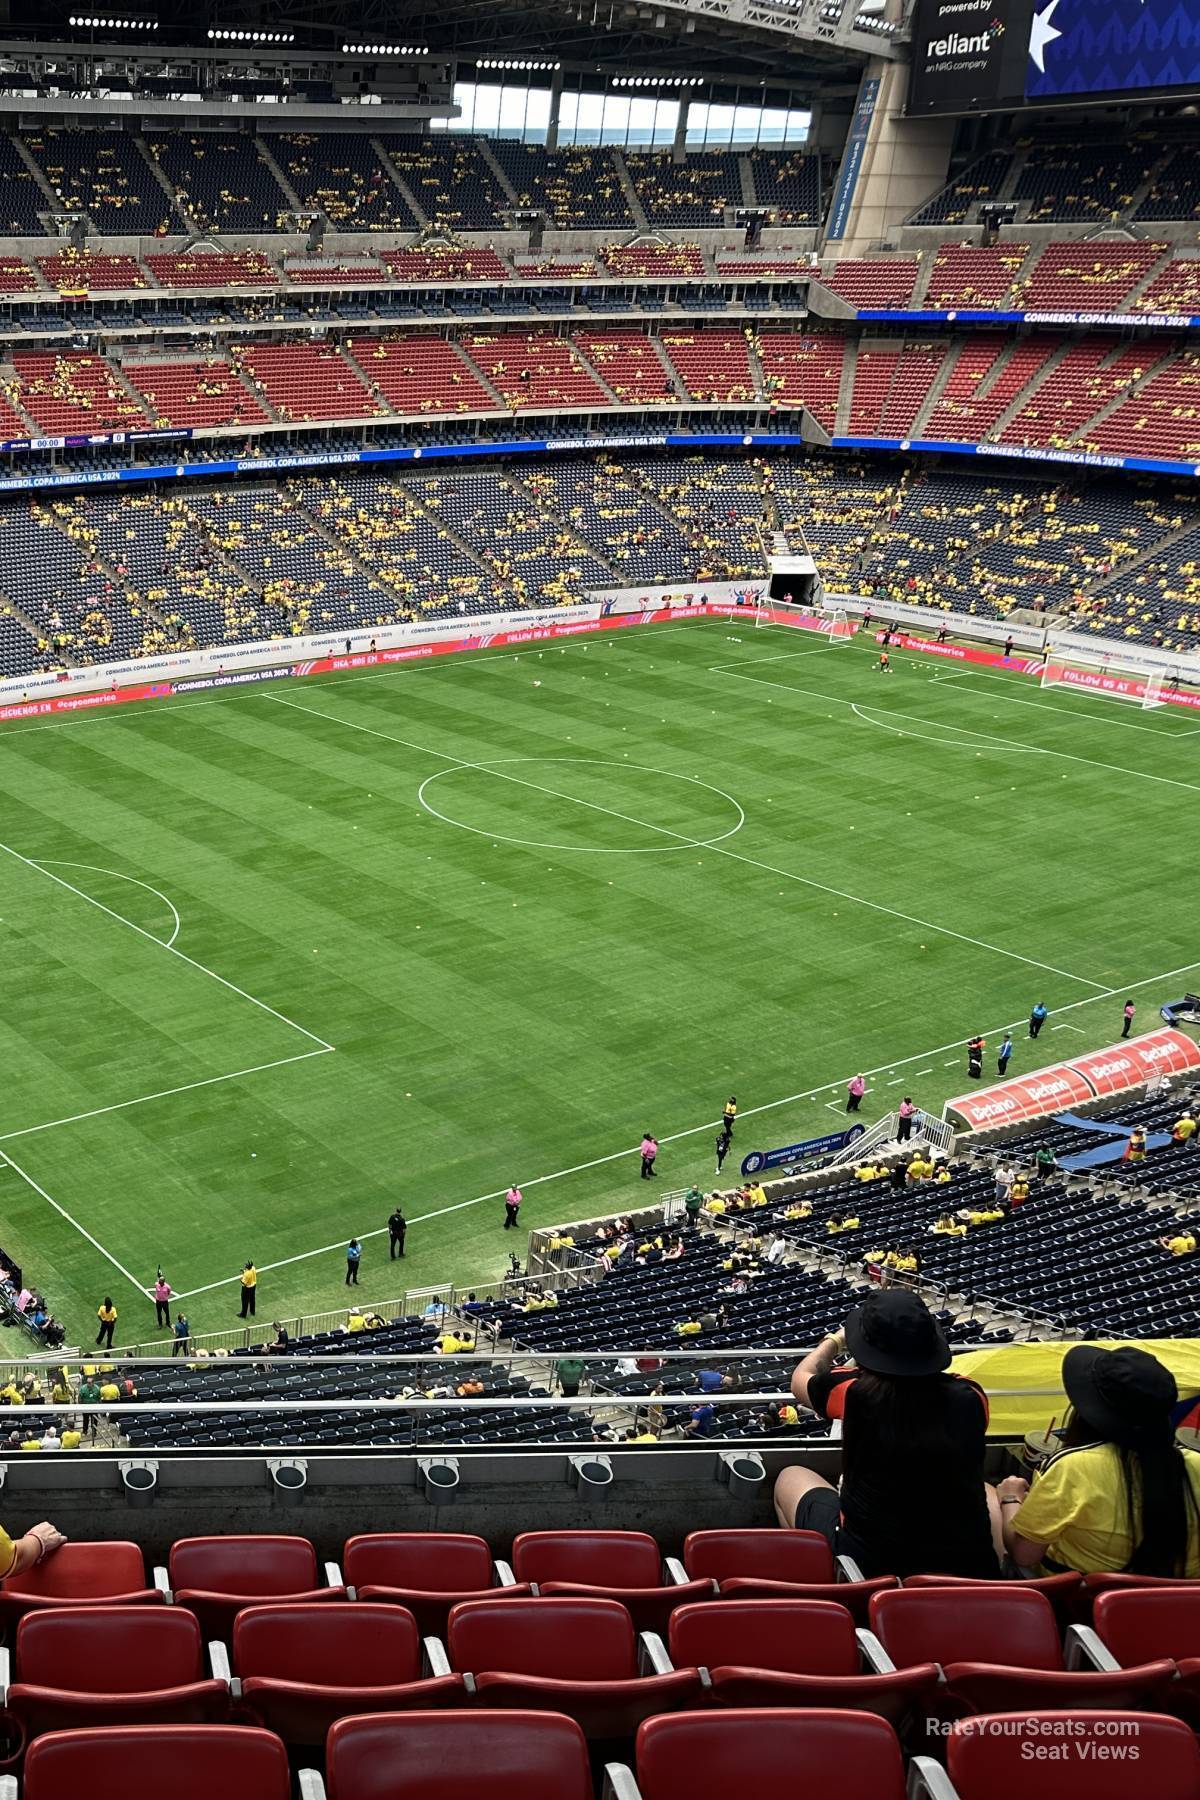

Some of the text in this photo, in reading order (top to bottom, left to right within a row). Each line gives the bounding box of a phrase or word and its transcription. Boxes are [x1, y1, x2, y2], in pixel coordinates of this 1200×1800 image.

[938, 0, 992, 17] powered by
[927, 31, 990, 57] reliant
[954, 59, 987, 72] company
[1024, 313, 1078, 323] CONMEBOL
[1078, 314, 1105, 323] COPA
[1105, 315, 1146, 324] AMERICA
[1147, 316, 1166, 325] USA
[546, 439, 584, 450] CONMEBOL
[585, 439, 605, 448] COPA
[605, 438, 634, 447] AMERICA
[975, 445, 1024, 457] CONMEBOL
[1024, 449, 1047, 460] COPA
[1047, 452, 1084, 463] AMERICA
[237, 459, 277, 471] CONMEBOL
[278, 457, 299, 468] COPA
[298, 455, 329, 466] AMERICA
[33, 477, 54, 487] COPA
[54, 474, 86, 485] AMERICA
[86, 473, 102, 483] USA
[178, 678, 214, 691] CONMEBOL
[214, 676, 231, 687] COPA
[231, 673, 261, 685] AMERICA
[1090, 1058, 1130, 1080] Betano
[1027, 1079, 1069, 1101] Betano
[971, 1099, 1015, 1121] Betano
